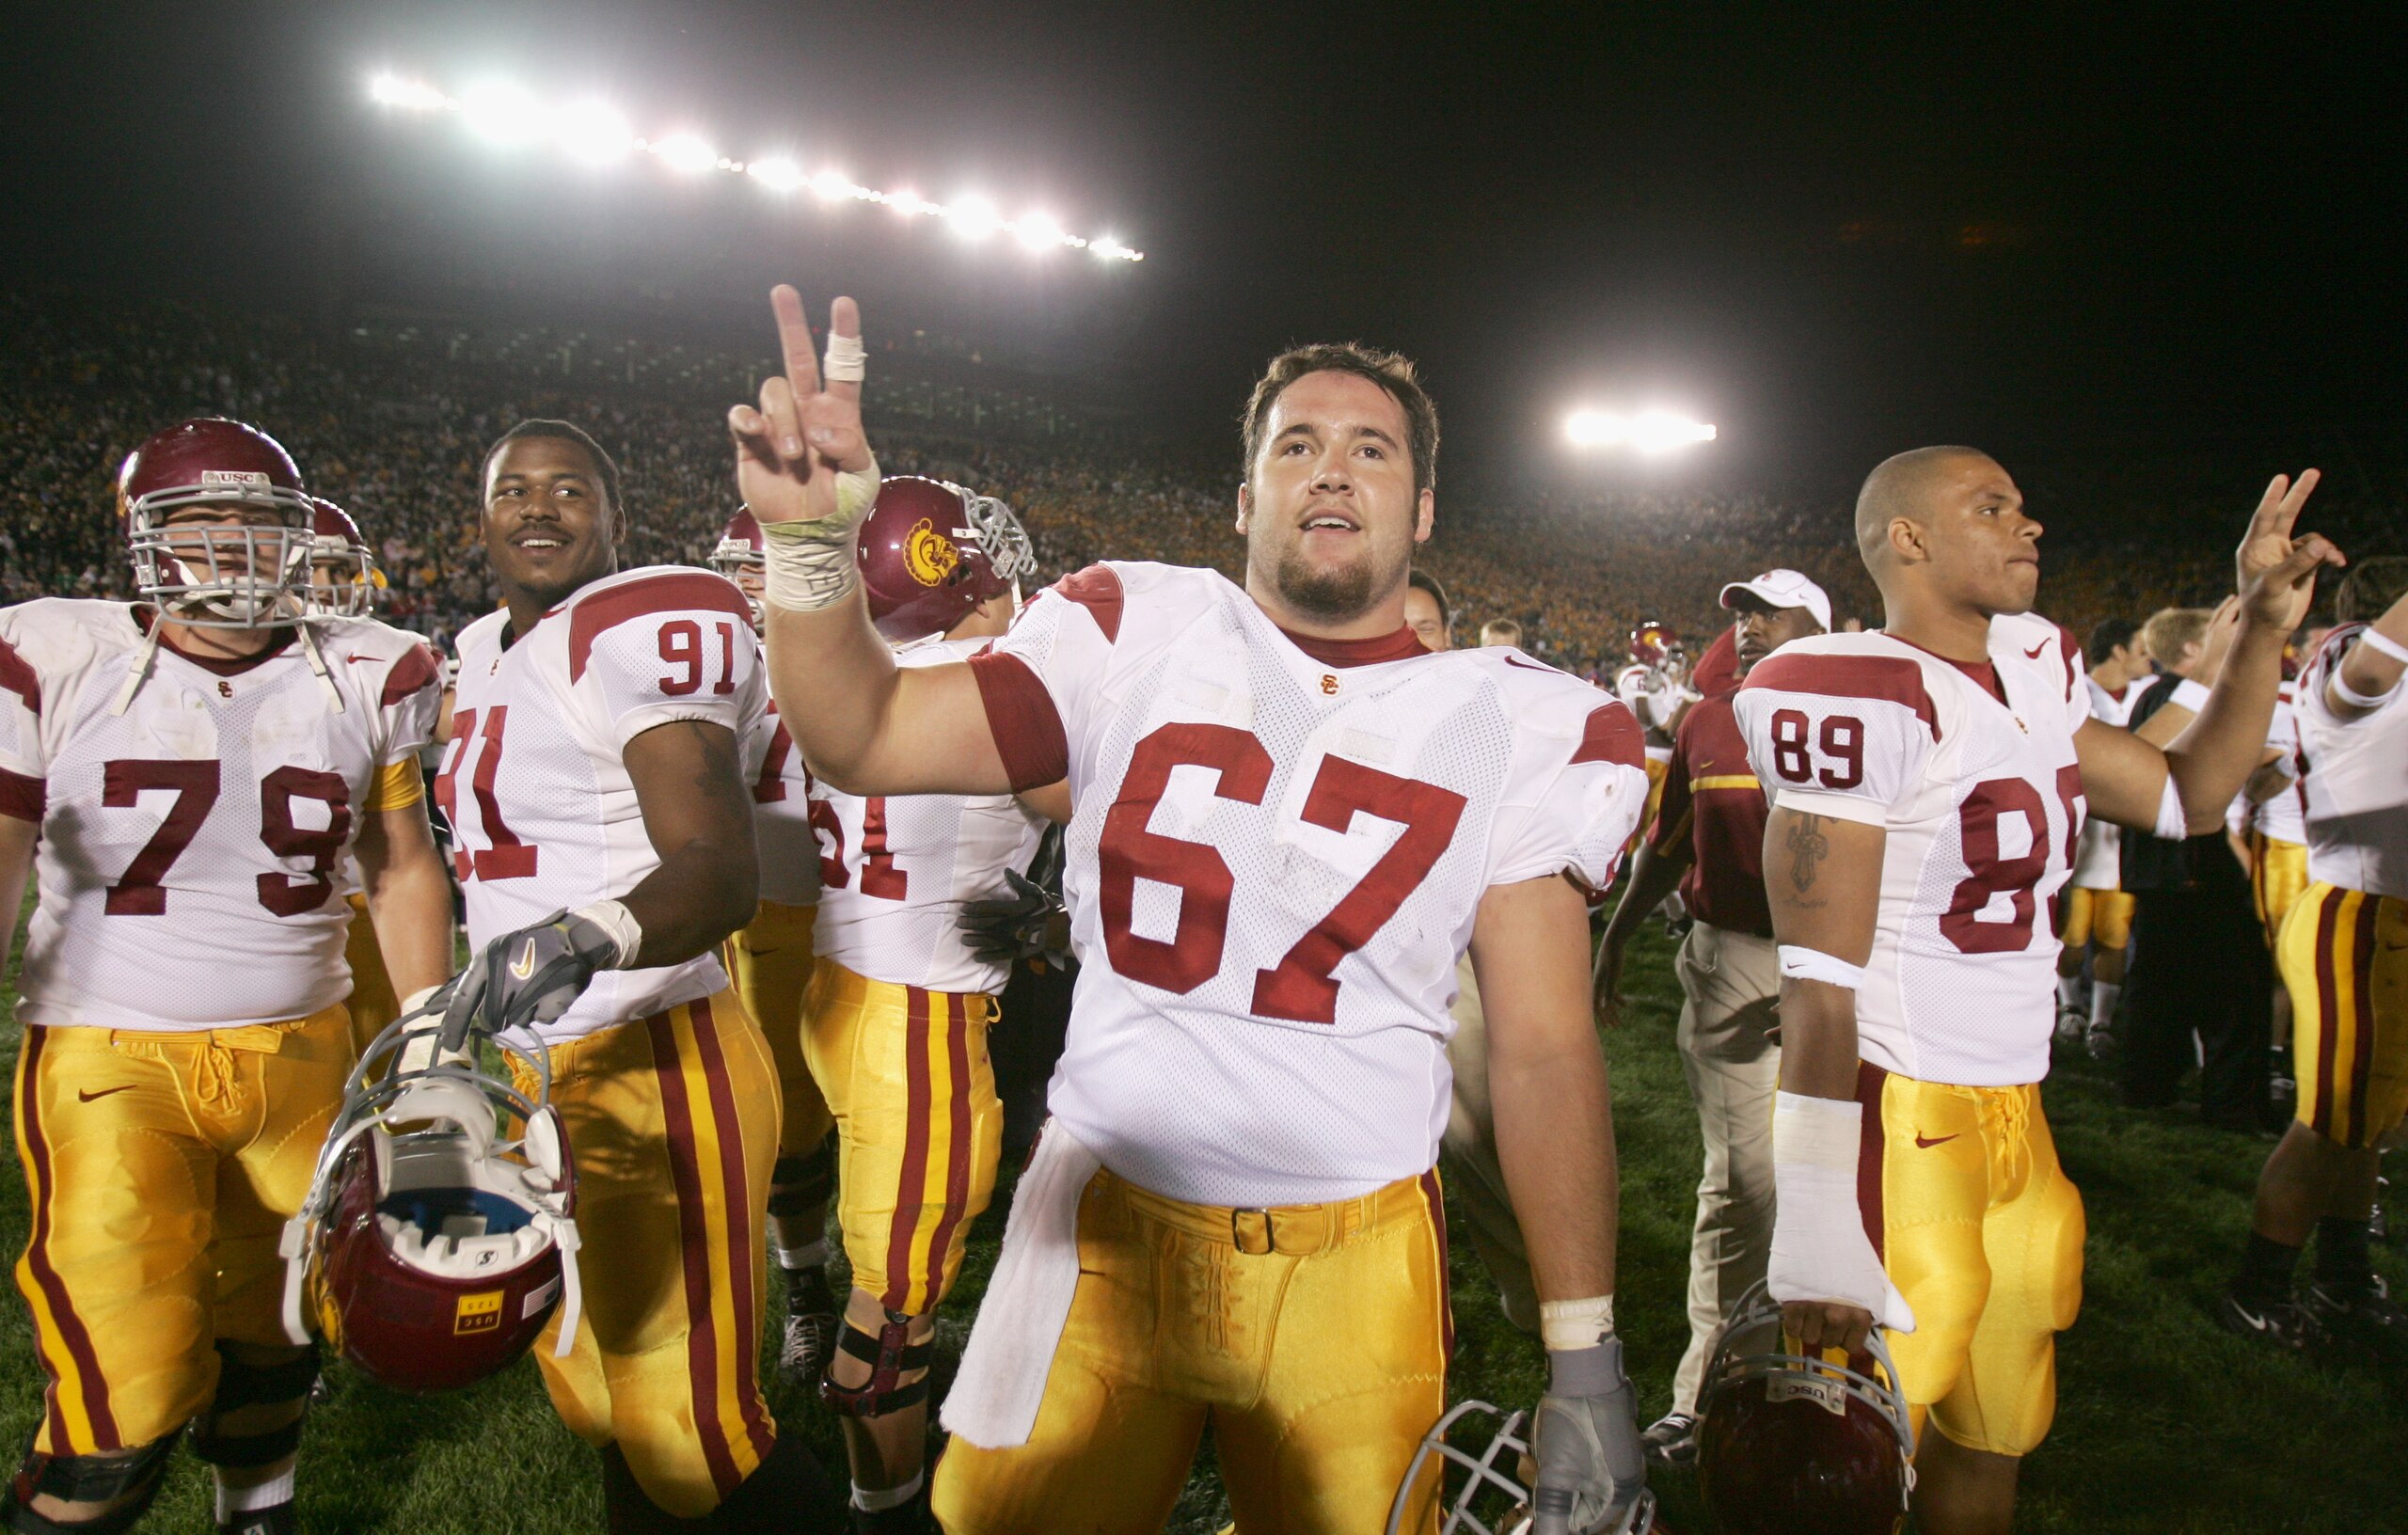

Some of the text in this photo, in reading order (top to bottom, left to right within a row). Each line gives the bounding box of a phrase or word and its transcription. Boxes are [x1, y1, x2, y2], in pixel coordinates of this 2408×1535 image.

[220, 473, 255, 483] USC
[657, 619, 736, 696] 91
[1771, 708, 1864, 789] 89
[434, 705, 538, 882] 91
[102, 759, 351, 918] 79
[1099, 722, 1468, 1025] 67
[465, 1316, 493, 1327] USC
[1787, 1385, 1825, 1400] USC
